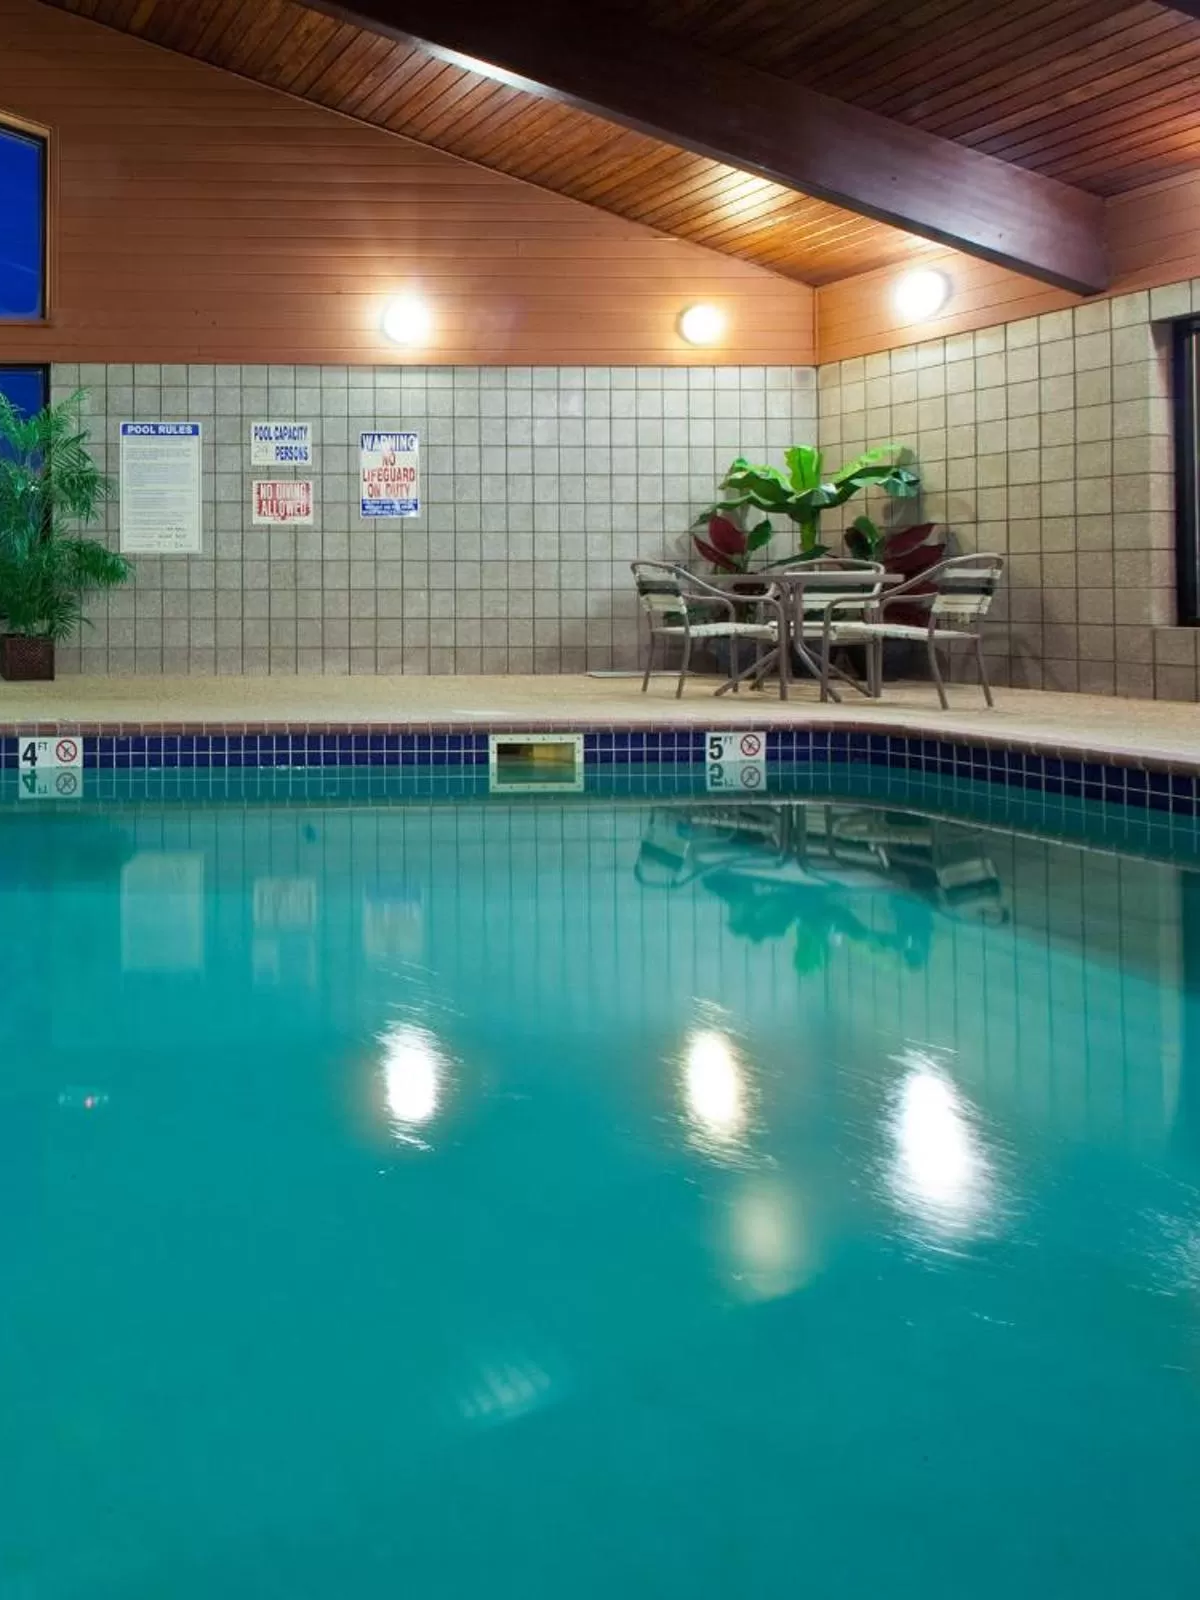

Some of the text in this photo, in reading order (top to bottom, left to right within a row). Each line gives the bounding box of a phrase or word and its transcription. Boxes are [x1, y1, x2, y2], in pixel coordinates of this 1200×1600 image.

[127, 425, 193, 434] POOL RULES
[254, 425, 307, 440] POOL CAPACITY
[362, 435, 417, 451] WARNING
[275, 446, 308, 460] PERSONS
[383, 451, 396, 466] NO
[363, 467, 416, 482] LIFEGUARD
[260, 484, 273, 499] NO
[368, 483, 411, 498] ON DUTY
[261, 499, 307, 514] ALLOWED
[22, 742, 48, 767] 4 FT
[709, 737, 724, 760] 5
